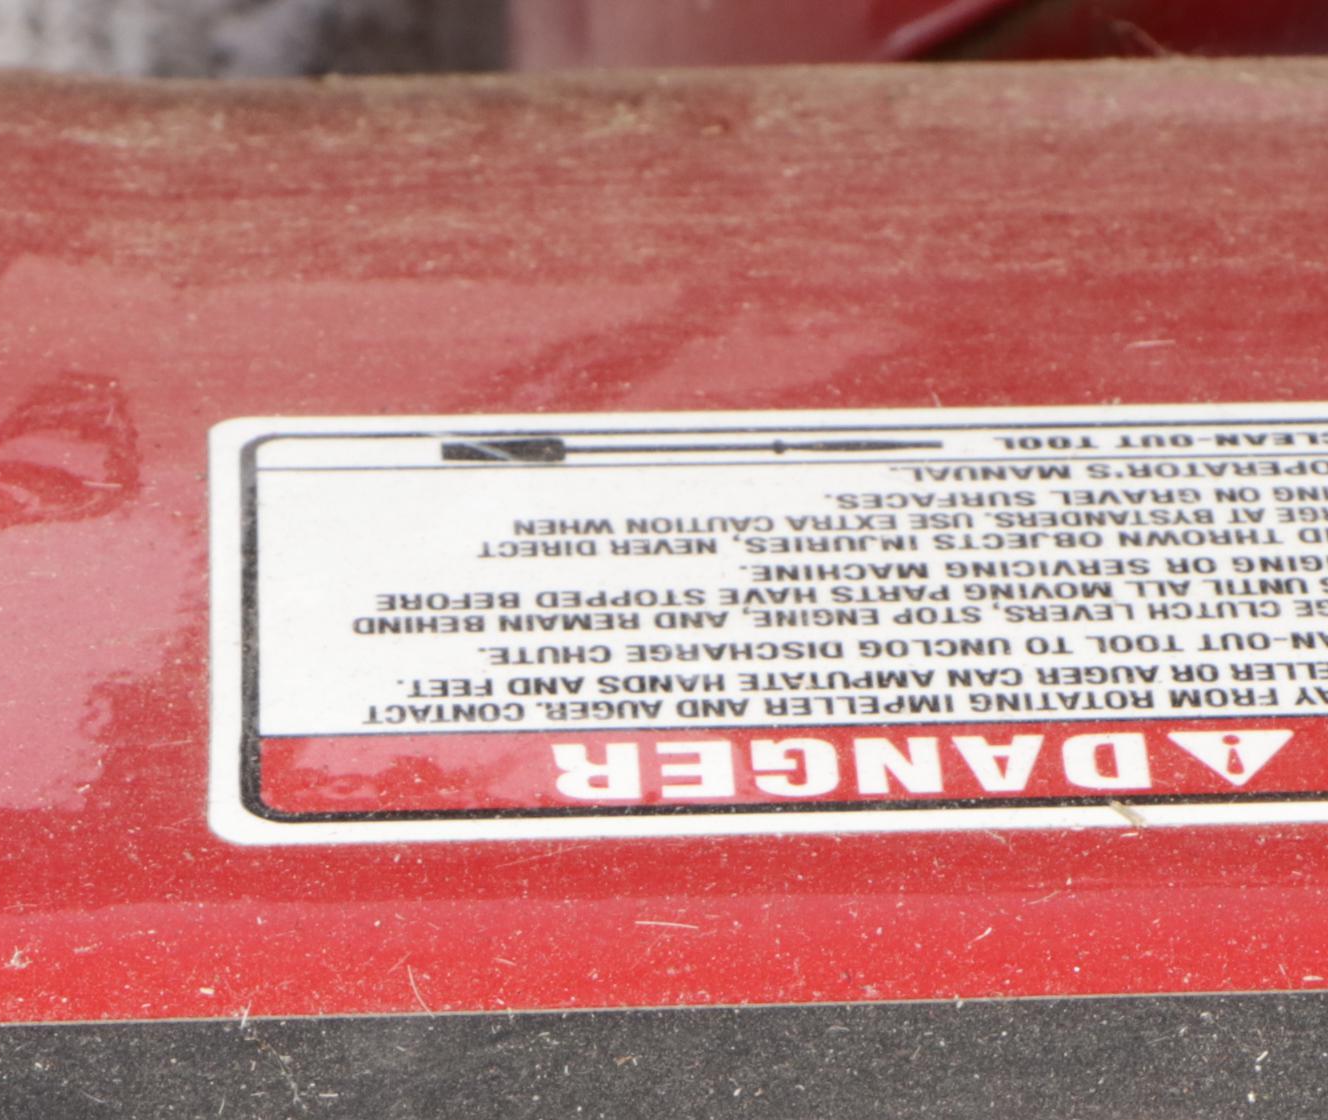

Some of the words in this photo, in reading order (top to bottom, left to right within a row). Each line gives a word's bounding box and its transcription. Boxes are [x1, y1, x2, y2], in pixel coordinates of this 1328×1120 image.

[1003, 437, 1095, 450] TOOL
[891, 465, 1070, 481] MANUAL.
[827, 492, 1035, 509] SURFACES.
[1056, 489, 1201, 505] GRAVEL
[1215, 488, 1260, 502] ON
[627, 517, 774, 533] CAUTION
[787, 515, 896, 531] EXTRA
[912, 514, 973, 529] USE
[987, 509, 1214, 528] BYSTANDERS.
[1230, 509, 1264, 523] AT
[514, 520, 613, 535] WHEN
[733, 536, 917, 553] INJURIES,
[933, 532, 1102, 550] OBJECTS
[1119, 529, 1278, 546] THROWN
[480, 541, 596, 557] DIRECT
[611, 539, 716, 555] NEVER
[742, 563, 928, 581] MACHINE.
[945, 559, 1150, 578] SERVICING
[1166, 558, 1216, 574] OR
[831, 585, 950, 603] PARTS
[964, 582, 1112, 600] MOVING
[1129, 581, 1190, 597] ALL
[1209, 578, 1308, 595] UNTIL
[379, 593, 520, 611] BEFORE
[536, 589, 705, 608] STOPPED
[721, 588, 816, 605] HAVE
[743, 608, 879, 627] ENGINE,
[893, 607, 981, 624] STOP
[993, 603, 1134, 622] LEVERS,
[1148, 601, 1280, 619] CLUTCH
[354, 616, 485, 634] BEHIND
[499, 613, 639, 631] REMAIN
[654, 612, 728, 629] AND
[629, 642, 843, 662] DISCHARGE
[859, 638, 1011, 658] UNCLOG
[1026, 637, 1071, 655] TO
[1087, 635, 1179, 653] TOOL
[480, 645, 611, 664] CHUTE.
[740, 670, 934, 691] AMPUTATE
[948, 668, 1022, 687] CAN
[1037, 666, 1158, 685] AUGER
[1171, 664, 1219, 682] OR
[399, 679, 493, 697] FEET.
[508, 677, 584, 695] AND
[597, 674, 725, 694] HANDS
[765, 695, 953, 716] IMPELLER
[969, 690, 1154, 712] ROTATING
[1169, 688, 1278, 708] FROM
[369, 703, 524, 723] CONTACT
[537, 700, 662, 720] AUGER.
[676, 699, 748, 718] AND
[551, 732, 1152, 799] DANGER
